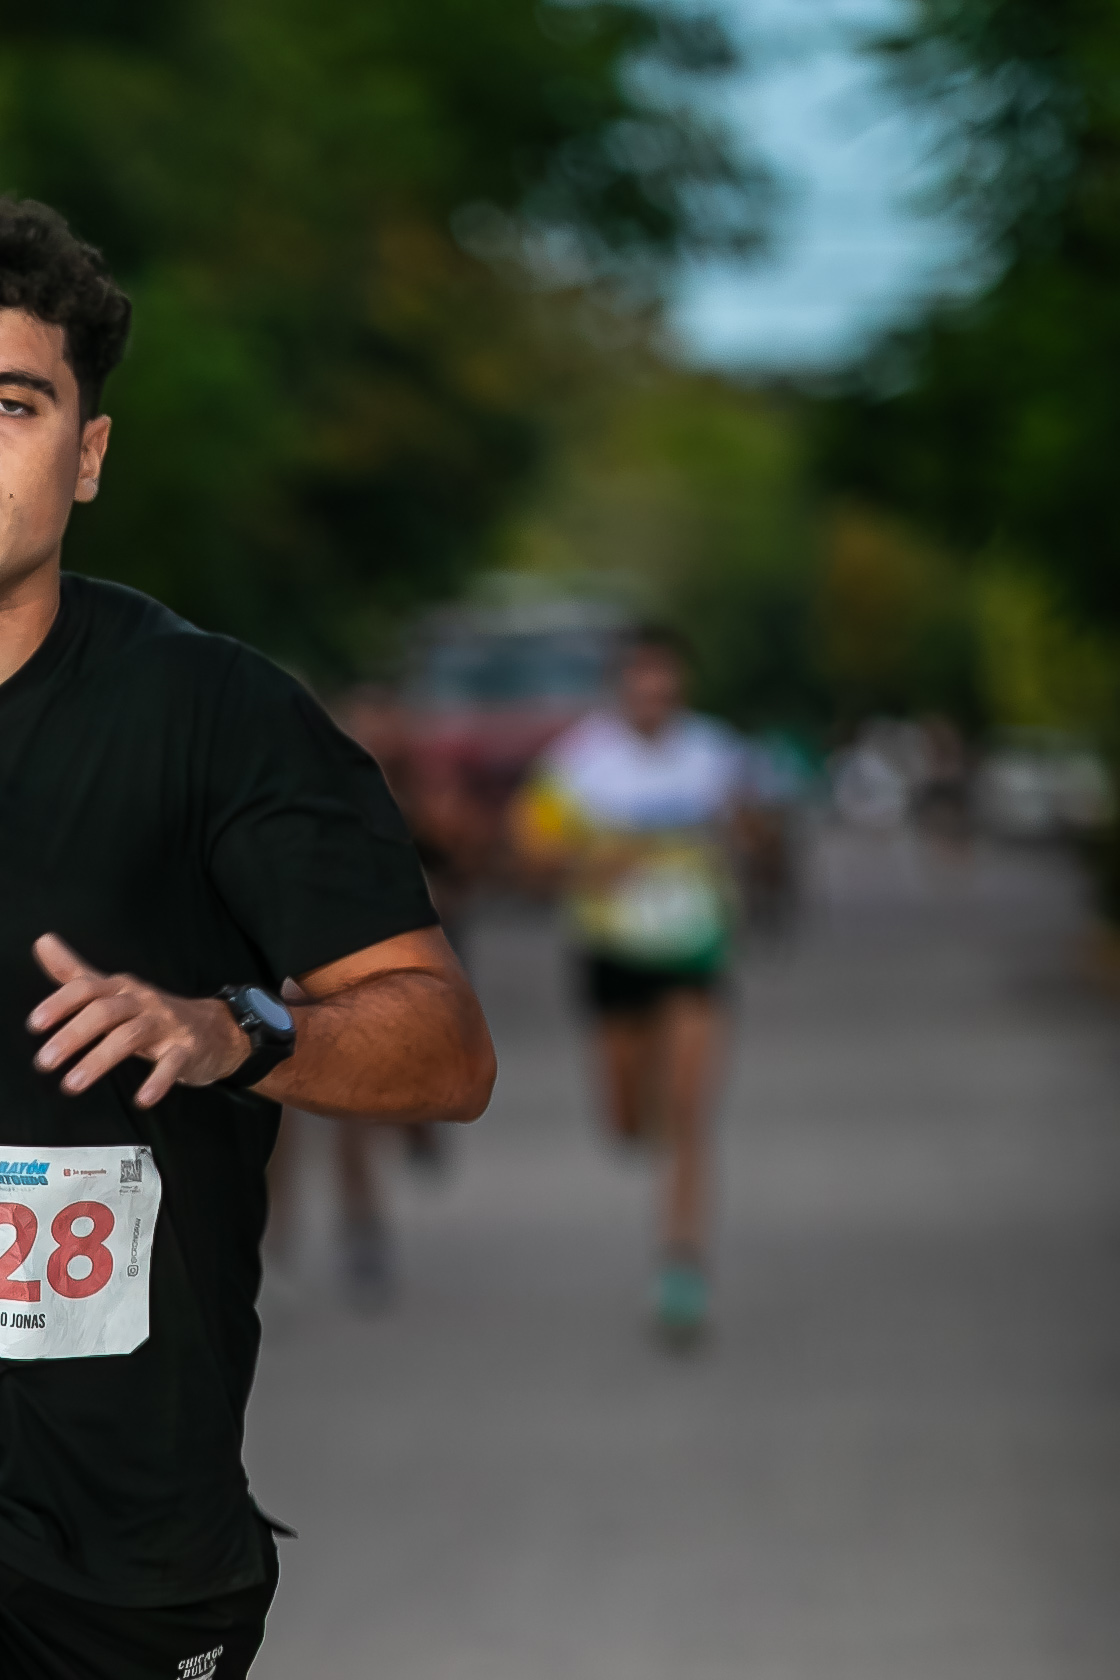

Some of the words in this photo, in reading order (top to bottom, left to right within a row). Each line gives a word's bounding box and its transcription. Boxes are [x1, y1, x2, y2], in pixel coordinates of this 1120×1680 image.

[10, 1313, 46, 1329] JONAS
[178, 1645, 224, 1670] CHICAGO
[183, 1659, 216, 1679] BULLS
